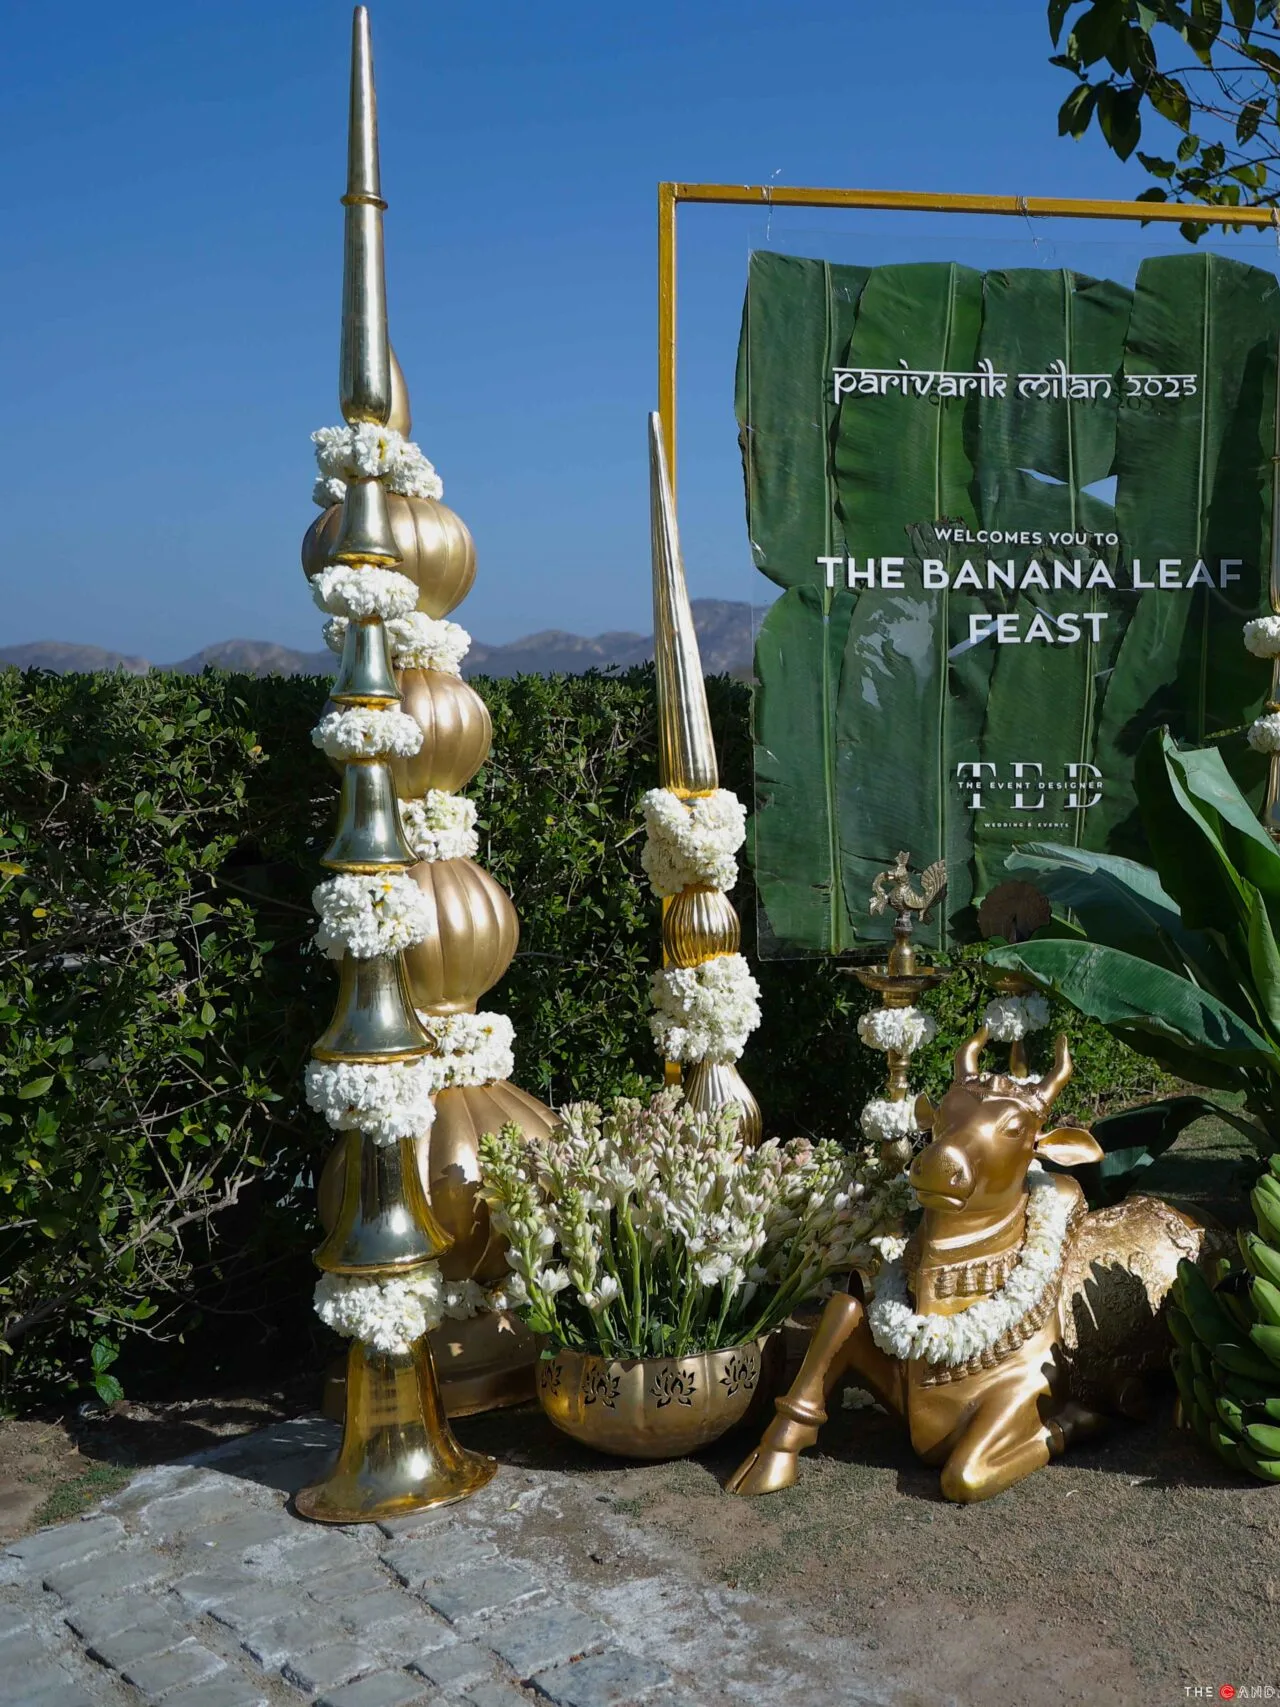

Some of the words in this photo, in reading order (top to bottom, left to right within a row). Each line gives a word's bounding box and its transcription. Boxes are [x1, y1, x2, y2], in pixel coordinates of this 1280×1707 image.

[832, 358, 1008, 404] parivarik
[1018, 359, 1112, 399] milan
[1124, 374, 1198, 398] 2025
[934, 527, 1042, 545] WELCOMES
[1049, 532, 1087, 546] YOU
[1094, 532, 1119, 546] TO
[817, 556, 905, 589] THE
[923, 558, 1116, 589] BANANA
[1133, 558, 1243, 589] LEAF
[968, 611, 1109, 644] FEAST
[958, 781, 982, 789] THE
[990, 781, 1031, 789] EVENT
[1038, 781, 1103, 789] DESIGNER
